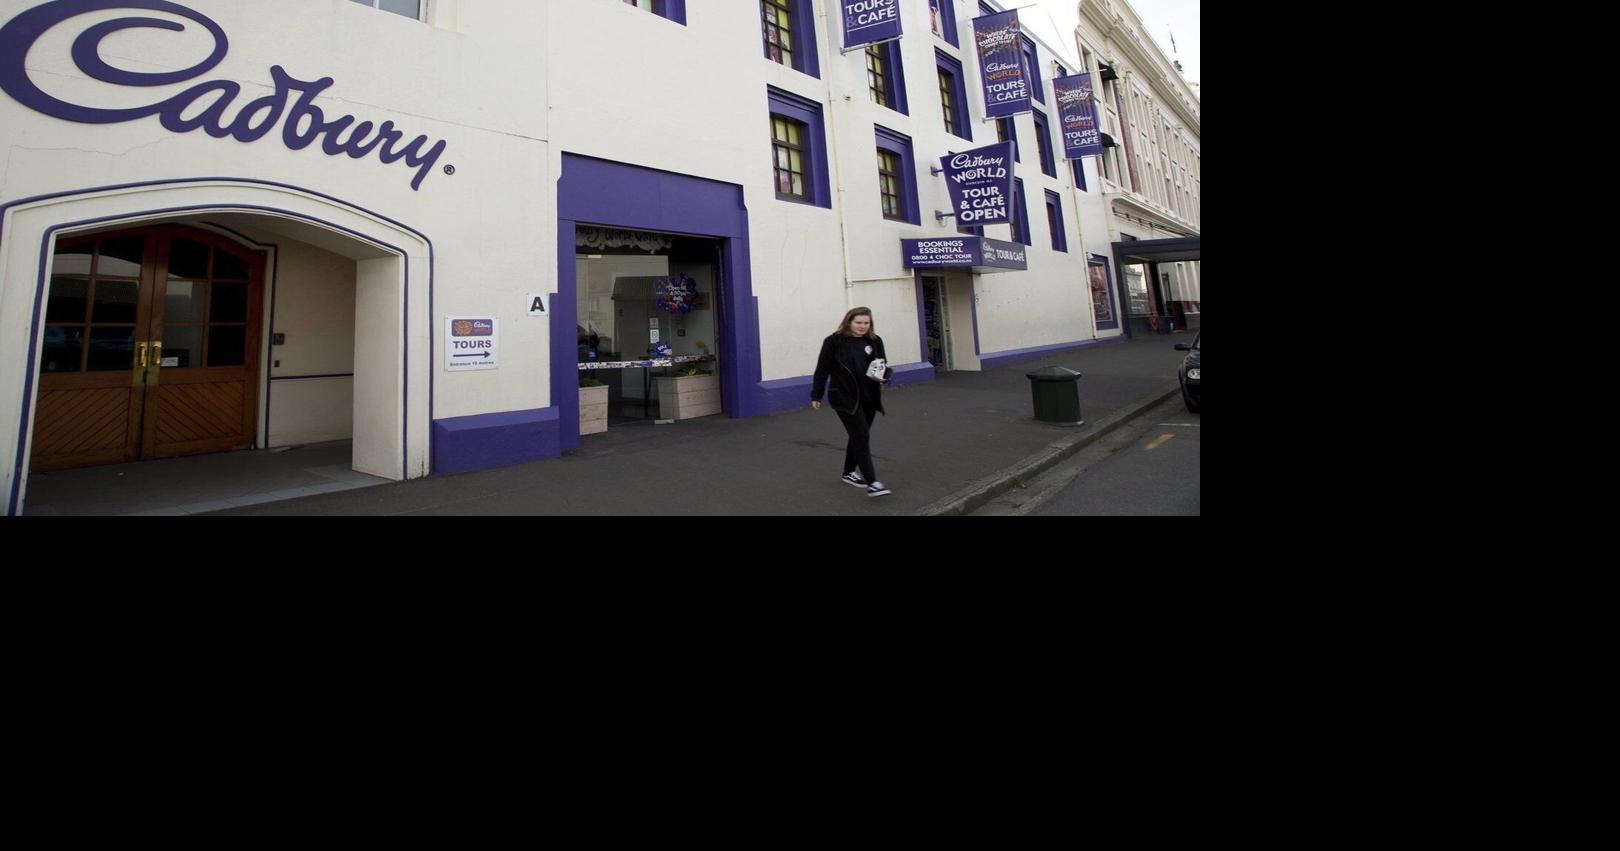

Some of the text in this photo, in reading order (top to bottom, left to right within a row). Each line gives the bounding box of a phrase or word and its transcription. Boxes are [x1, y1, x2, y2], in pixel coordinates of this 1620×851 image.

[857, 4, 897, 25] CAFÉ
[985, 62, 1019, 73] Cadbury
[986, 69, 1022, 81] WORLD
[986, 79, 1025, 93] TOURS
[0, 0, 446, 191] Cadbury
[996, 88, 1028, 101] CAFÉ
[1064, 128, 1098, 139] TOURS
[950, 153, 1004, 170] Cadbury
[951, 167, 1007, 184] WORLD
[962, 186, 1000, 199] TOUR
[960, 194, 1005, 210] & CAFÉ
[960, 206, 1007, 222] OPEN
[917, 240, 964, 248] BOOKINGS
[919, 246, 963, 254] ESSENTIAL
[996, 248, 1010, 260] TOUR
[529, 296, 546, 313] A
[452, 340, 492, 349] TOURS
